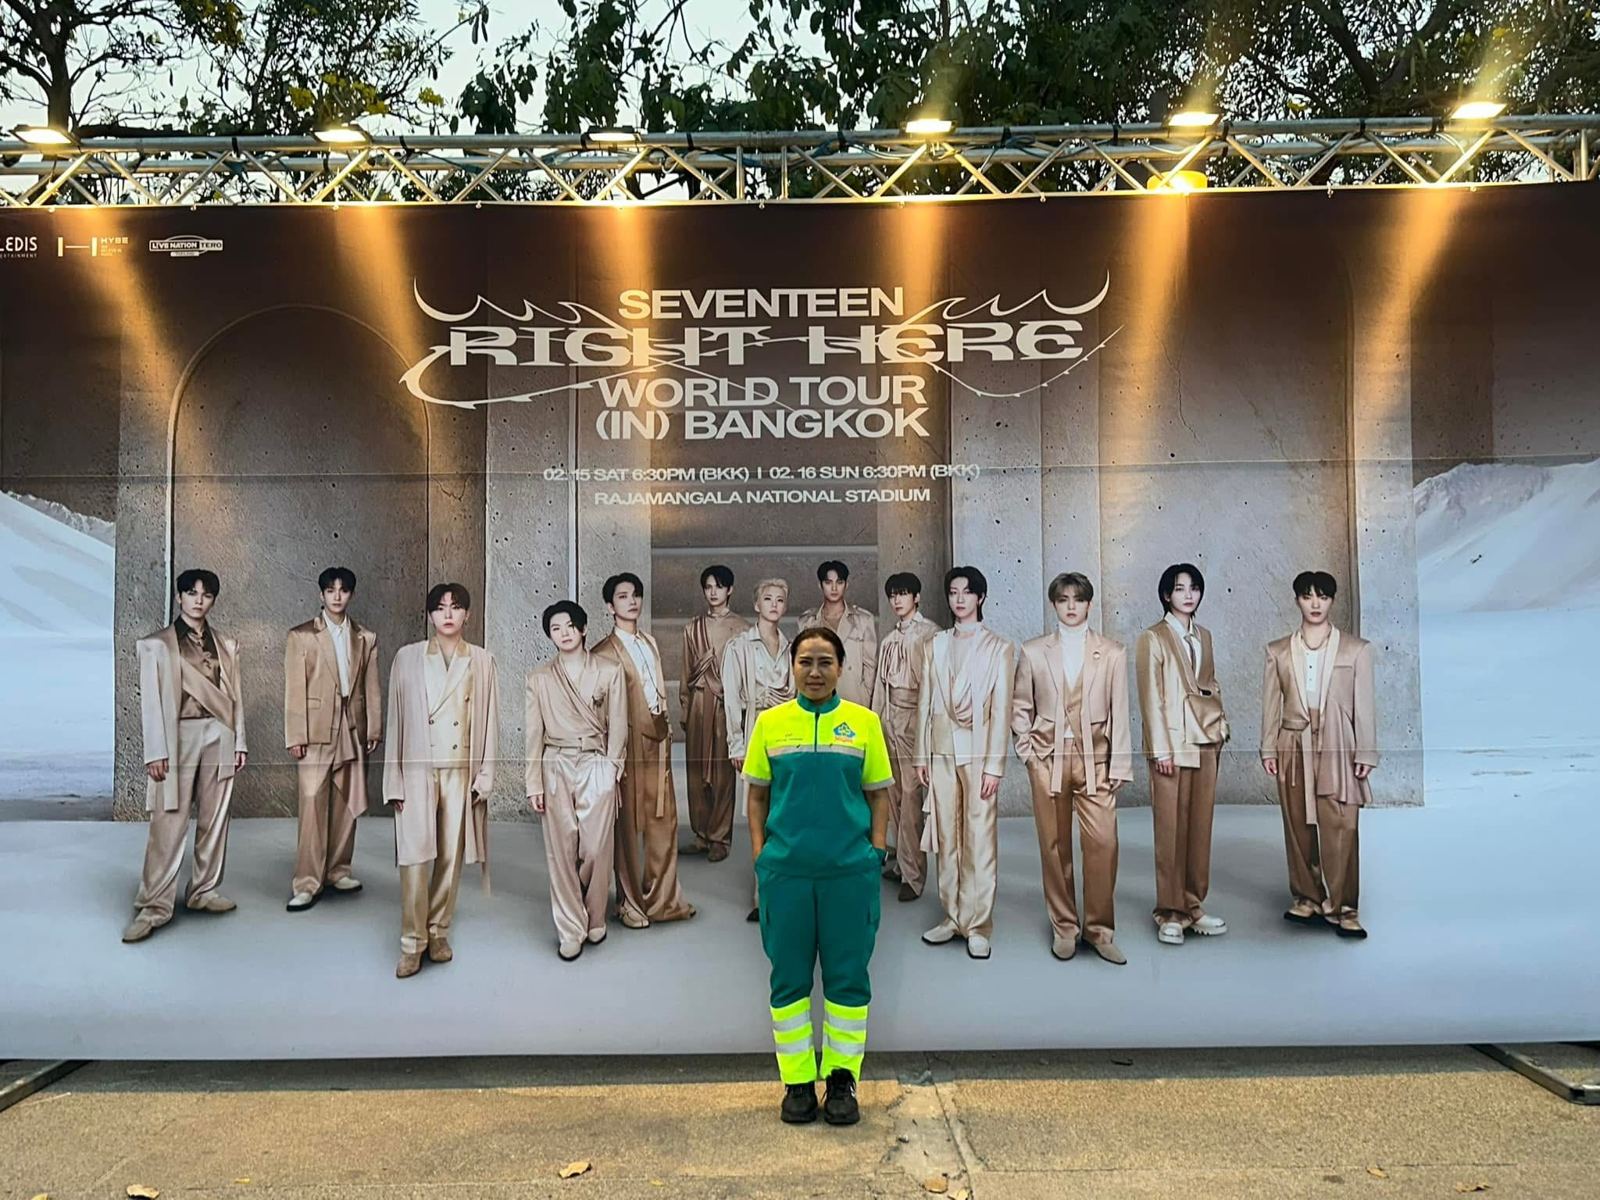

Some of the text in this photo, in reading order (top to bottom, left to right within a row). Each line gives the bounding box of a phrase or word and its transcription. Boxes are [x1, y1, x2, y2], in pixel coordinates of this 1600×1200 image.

[100, 236, 129, 245] HYBE
[618, 287, 904, 319] SEVENTEEN
[450, 320, 1084, 367] RIGHT HERE
[598, 375, 927, 408] WORLD TOUR
[595, 407, 930, 440] (IN) BANGKOK
[593, 468, 629, 481] SAT
[631, 468, 696, 481] 6:30PM
[699, 467, 750, 483] (BKK)
[819, 466, 860, 479] SUN
[862, 465, 927, 478] 6:30PM
[929, 464, 981, 480] (BKK)
[593, 489, 931, 505] RAJAMANGALA NATIONAL STADIUM
